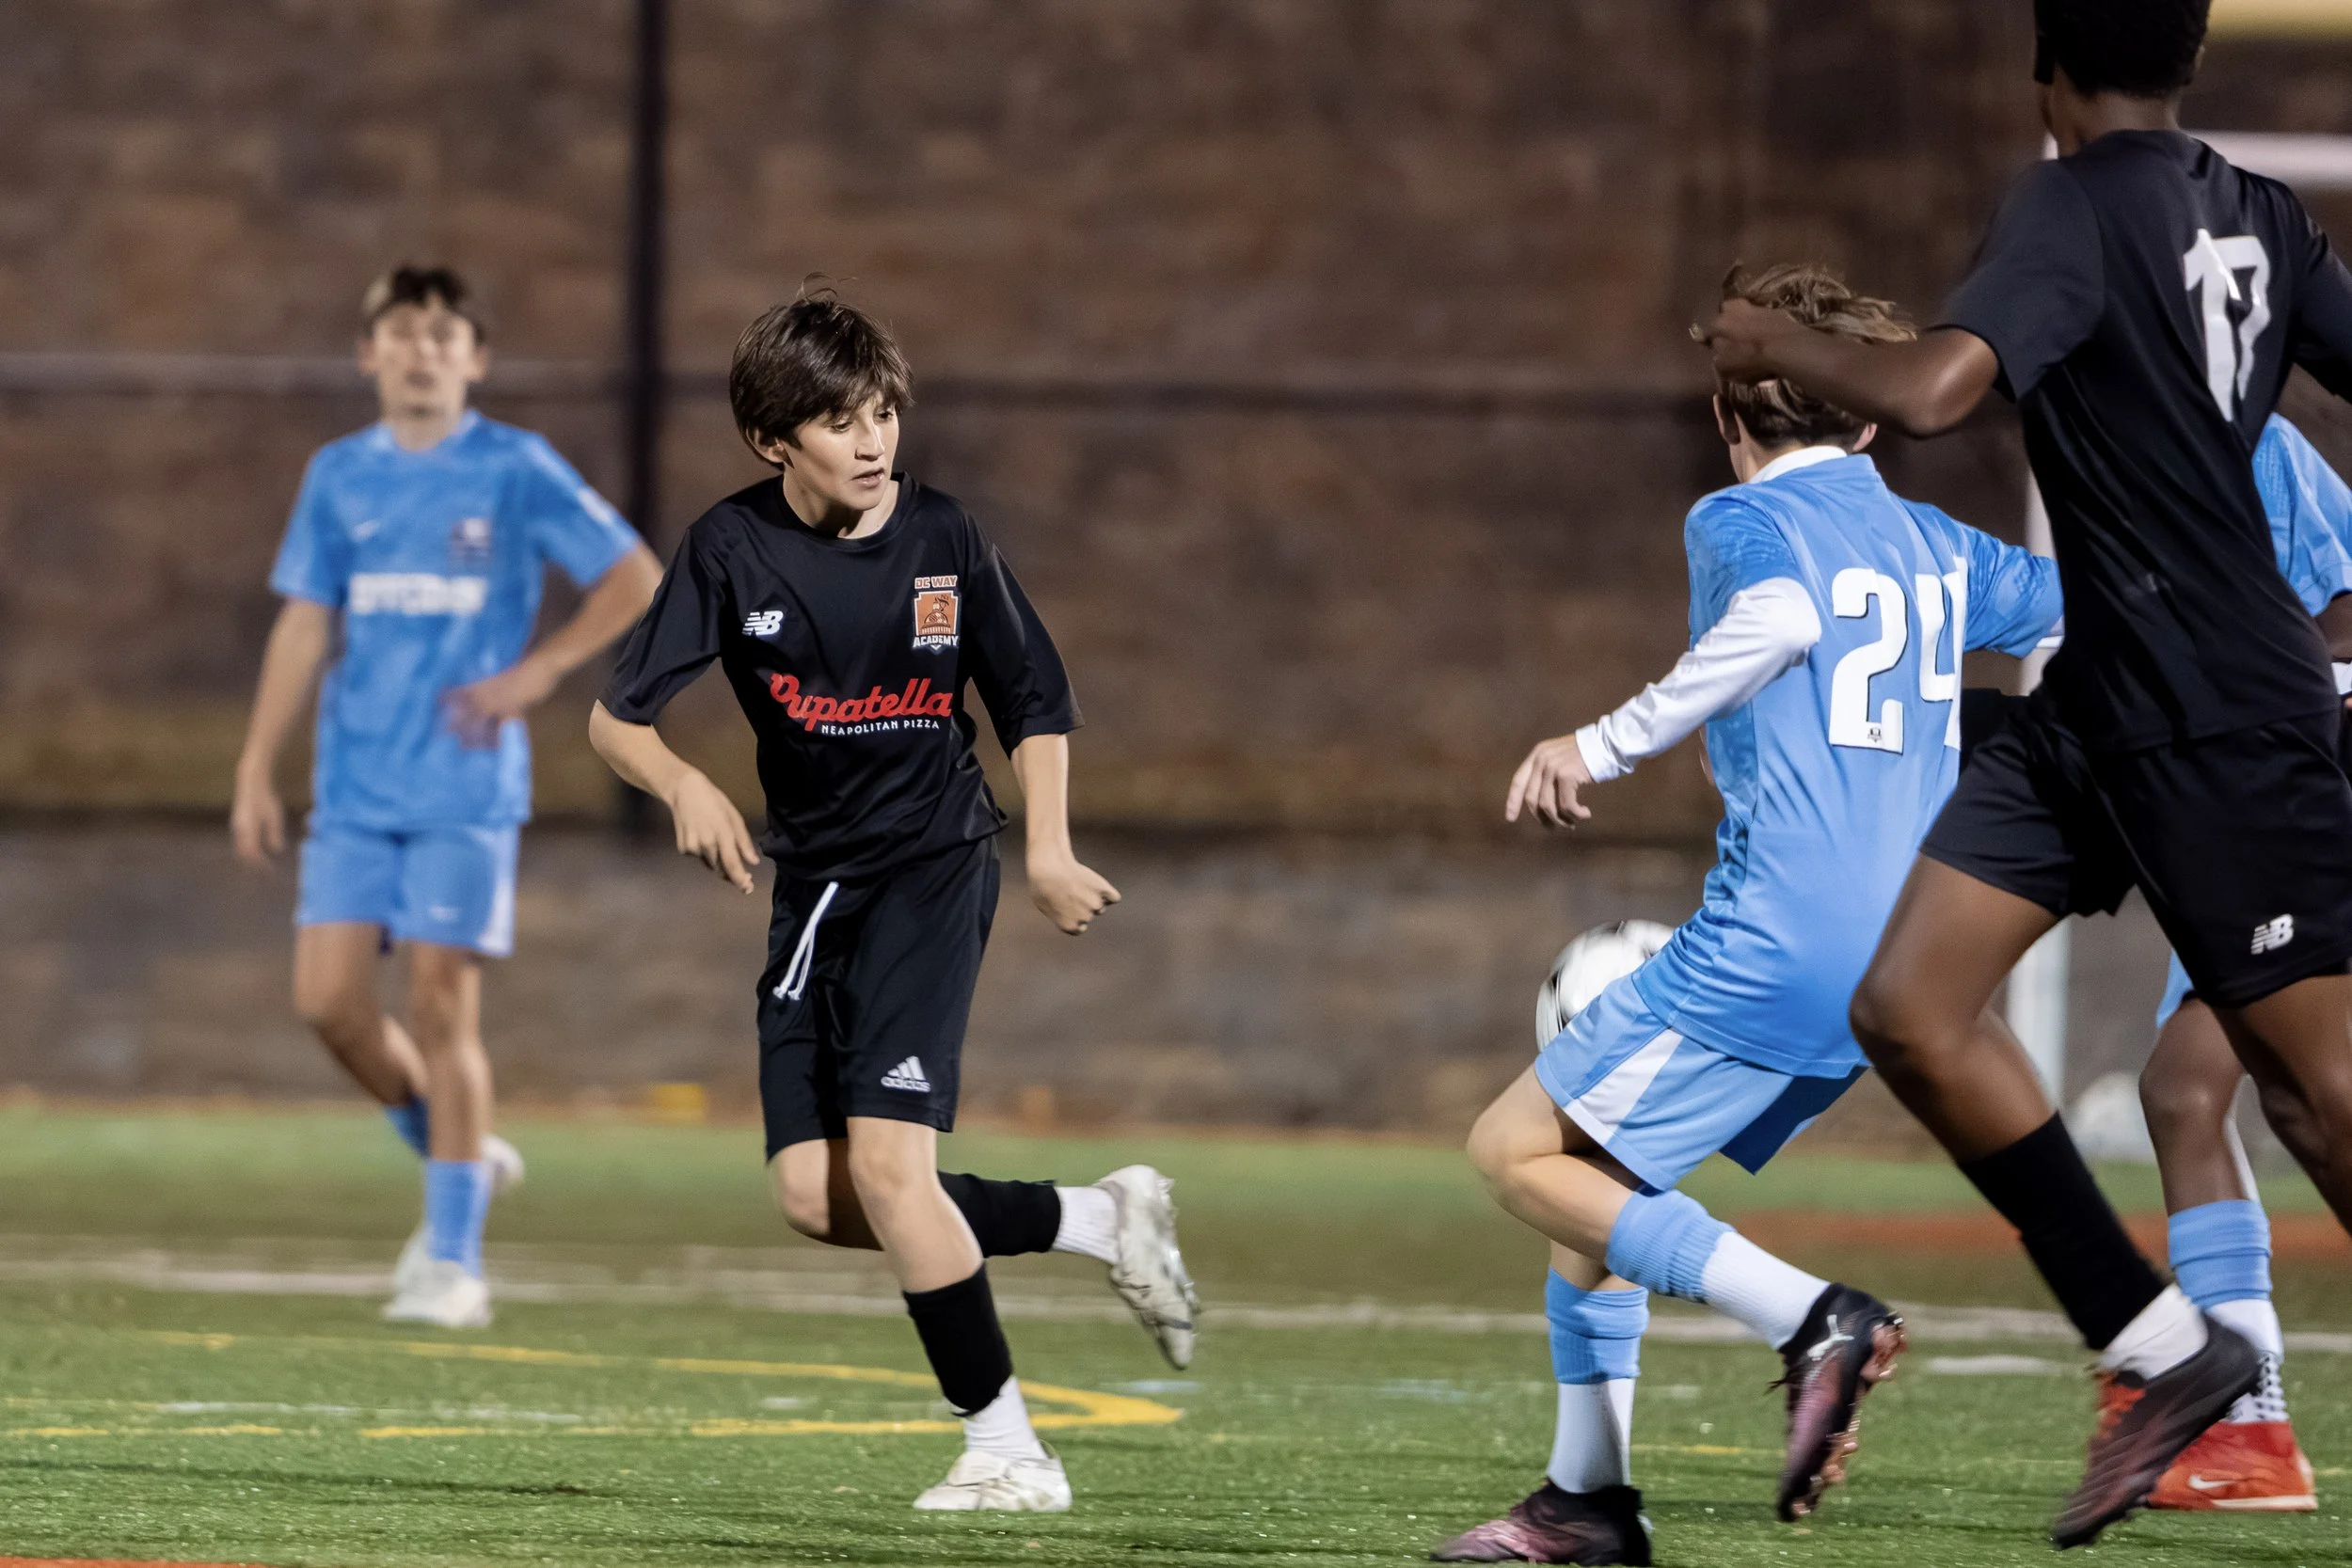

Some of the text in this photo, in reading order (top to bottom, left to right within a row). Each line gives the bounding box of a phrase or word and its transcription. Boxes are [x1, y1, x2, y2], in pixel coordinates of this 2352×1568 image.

[2183, 228, 2272, 423] 17
[914, 575, 958, 590] DC WAY
[913, 635, 959, 648] ACADEMY
[1828, 555, 1968, 756] 24
[770, 673, 954, 732] Pupatella
[820, 718, 940, 736] NEAPOLITAN PIZZA
